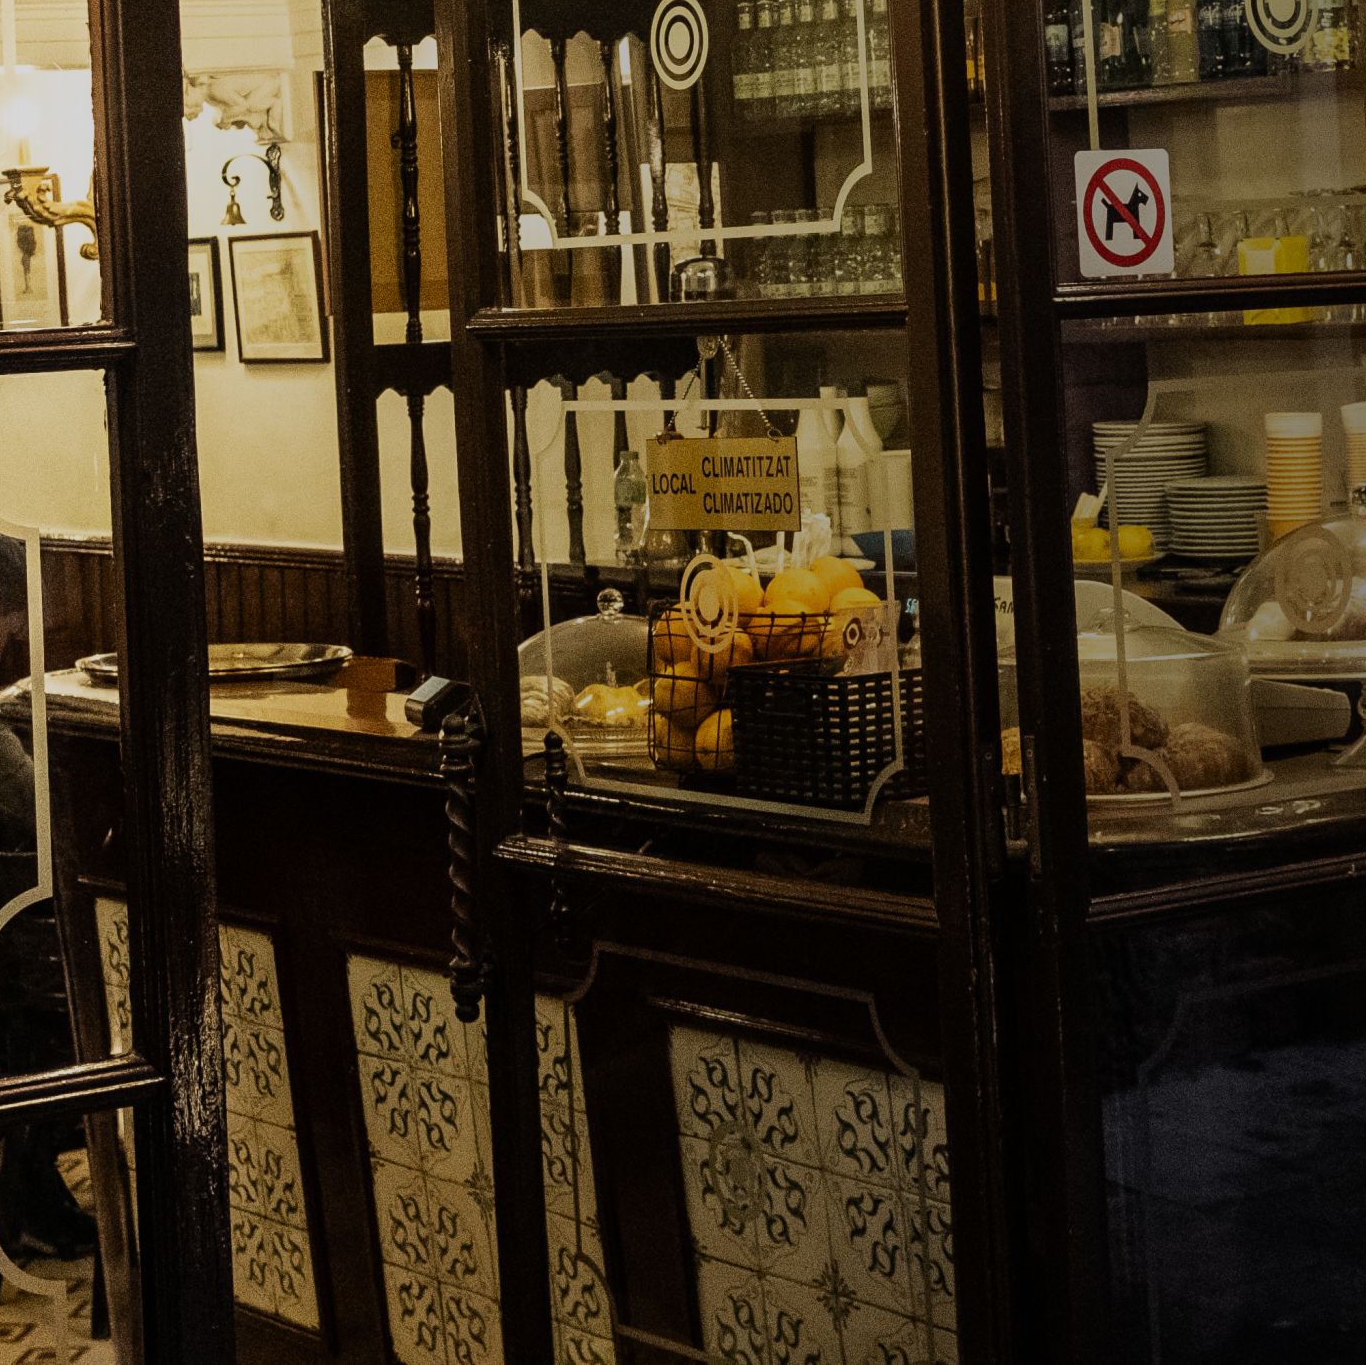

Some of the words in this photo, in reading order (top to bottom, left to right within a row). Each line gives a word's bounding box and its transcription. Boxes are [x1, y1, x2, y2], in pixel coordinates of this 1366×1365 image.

[701, 455, 791, 479] CLIMATITZAT
[651, 473, 697, 495] LOCAL
[702, 492, 794, 515] CLIMATIZADO
